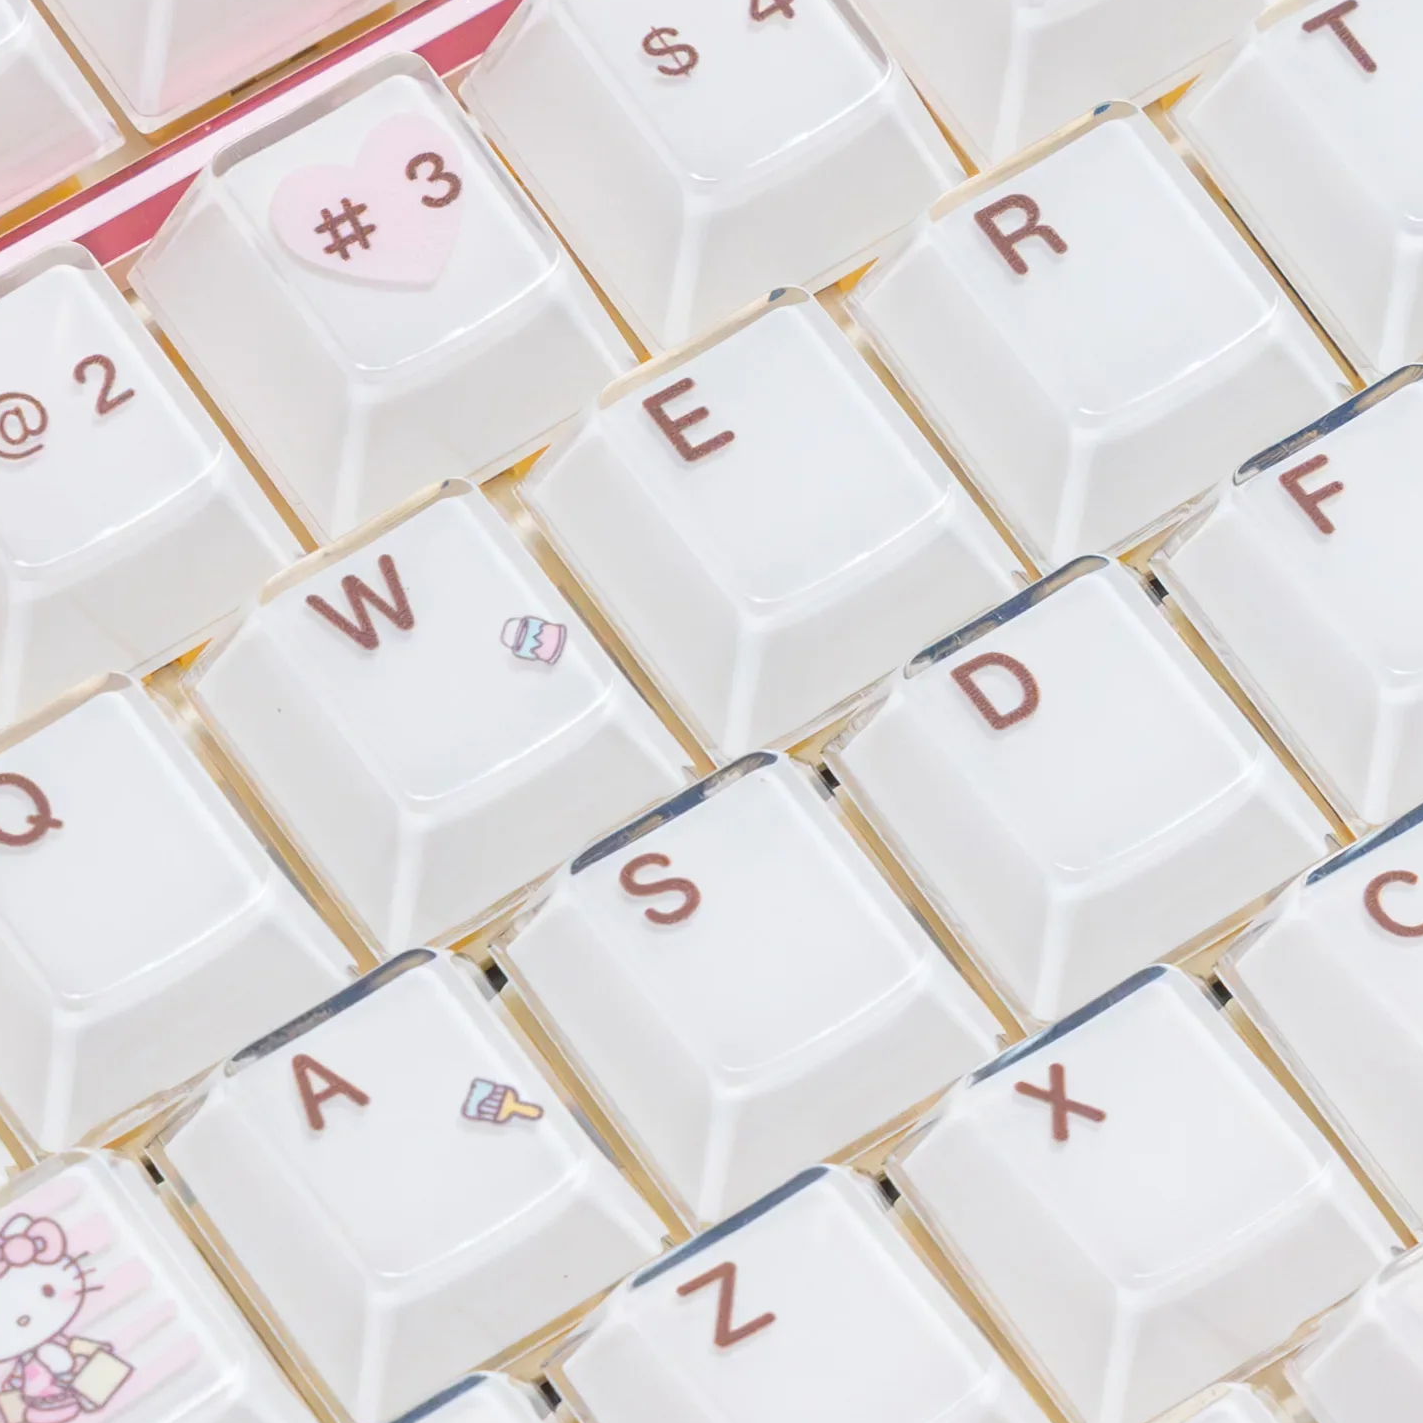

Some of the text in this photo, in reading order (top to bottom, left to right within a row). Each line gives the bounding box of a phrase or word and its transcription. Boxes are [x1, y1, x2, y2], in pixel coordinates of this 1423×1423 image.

[640, 25, 700, 78] $
[313, 150, 463, 262] # 3
[972, 192, 1069, 276] R
[72, 353, 136, 417] 2
[641, 376, 736, 464] E
[1277, 453, 1345, 536] F
[304, 553, 416, 652] W
[949, 650, 1041, 732] D
[618, 851, 702, 927] S
[290, 1053, 371, 1132] A
[1013, 1062, 1107, 1144] X
[675, 1260, 777, 1350] Z
